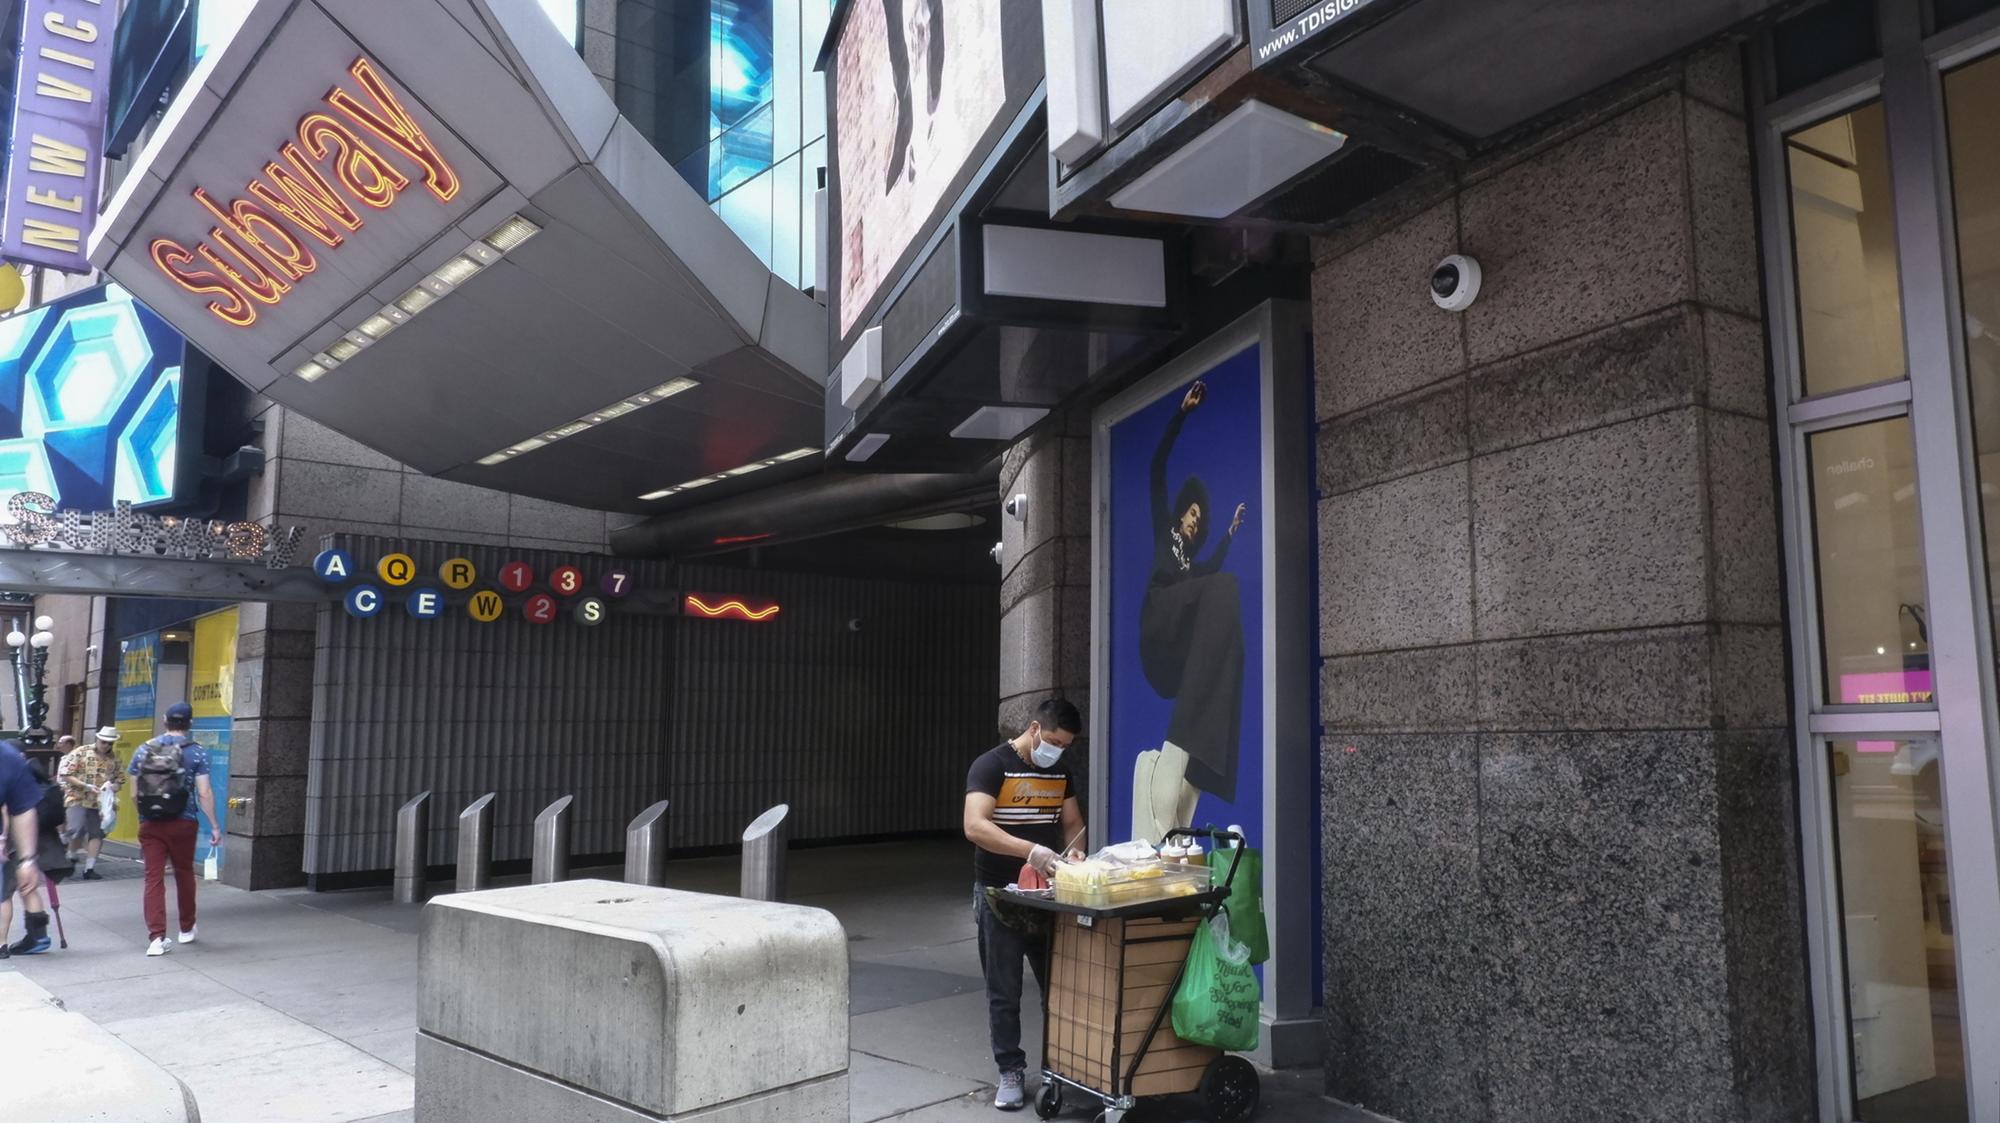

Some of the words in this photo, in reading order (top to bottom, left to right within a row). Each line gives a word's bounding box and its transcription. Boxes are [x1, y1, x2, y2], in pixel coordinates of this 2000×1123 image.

[35, 0, 101, 104] VIC
[21, 132, 88, 254] NEW
[147, 55, 461, 328] Subway
[1, 491, 306, 570] Subway
[324, 554, 347, 577] A
[387, 558, 408, 581] Q
[452, 563, 469, 583] R
[512, 567, 523, 587] 1
[560, 571, 576, 591] 3
[612, 573, 626, 593] 7
[355, 590, 377, 612] C
[418, 593, 436, 615] E
[476, 596, 498, 616] W
[534, 598, 550, 619] 2
[584, 601, 600, 621] S
